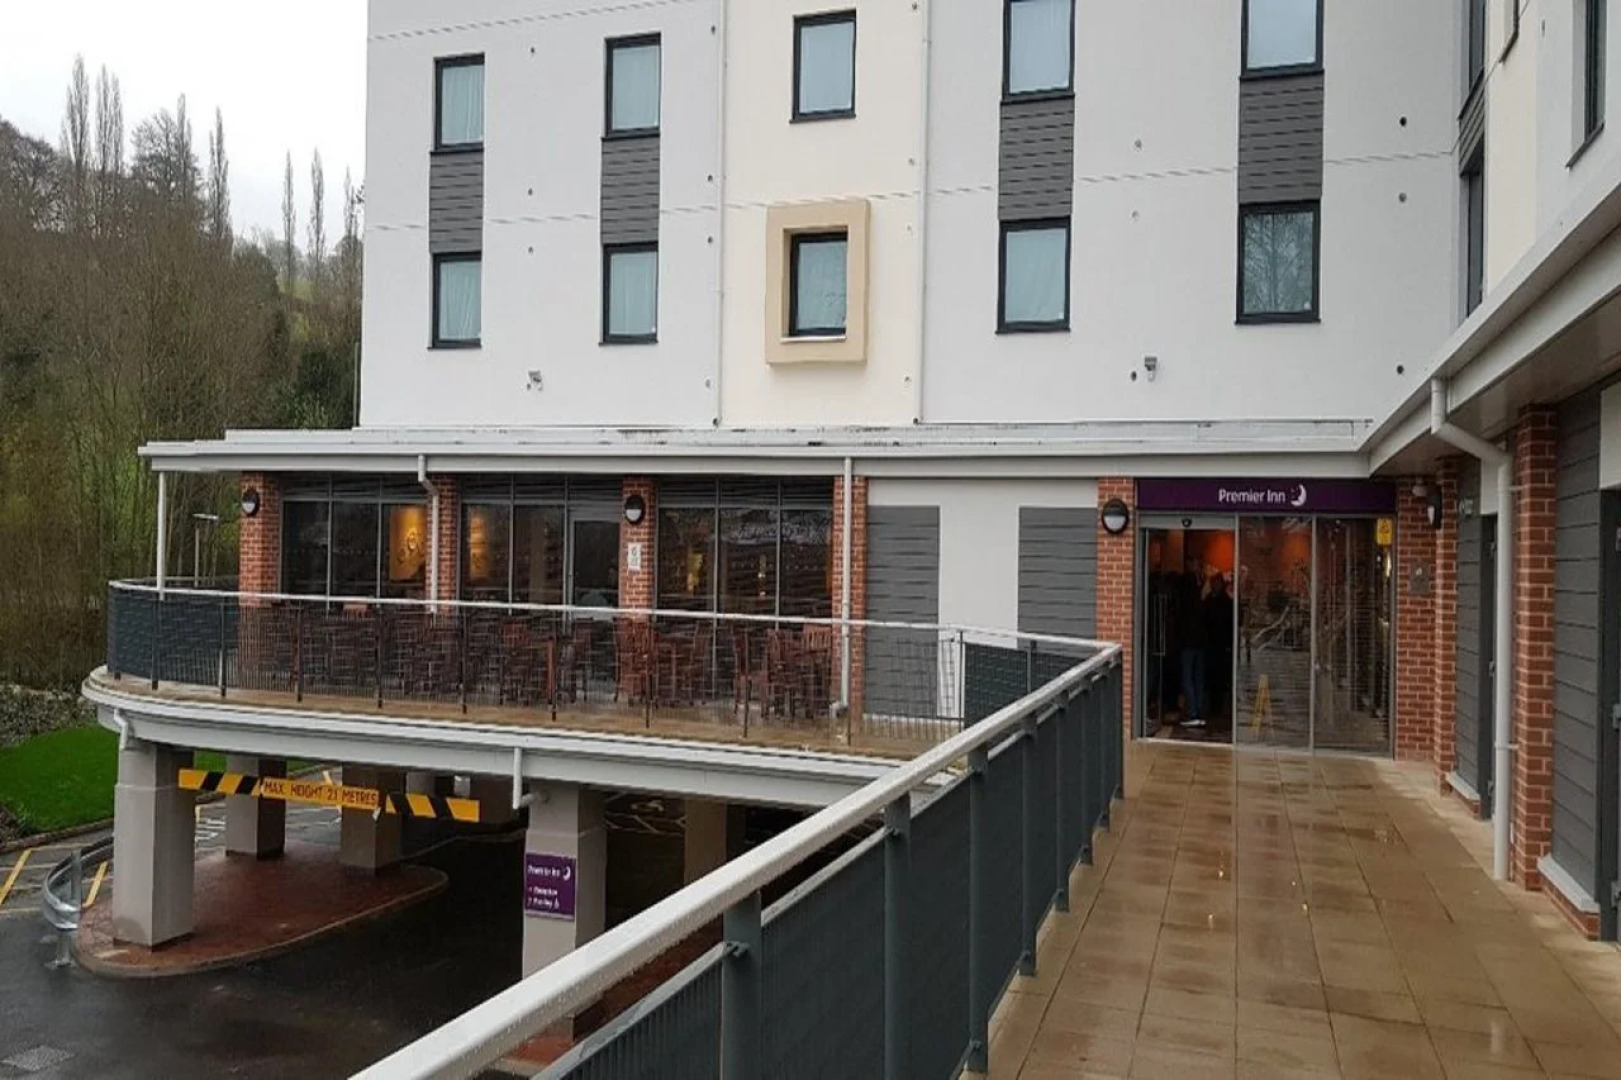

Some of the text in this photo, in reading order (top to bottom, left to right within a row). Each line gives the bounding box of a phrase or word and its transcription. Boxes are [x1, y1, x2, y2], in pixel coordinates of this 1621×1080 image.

[1218, 488, 1285, 503] Premier Inn
[290, 784, 323, 799] HEIGHT
[342, 790, 377, 805] METRES
